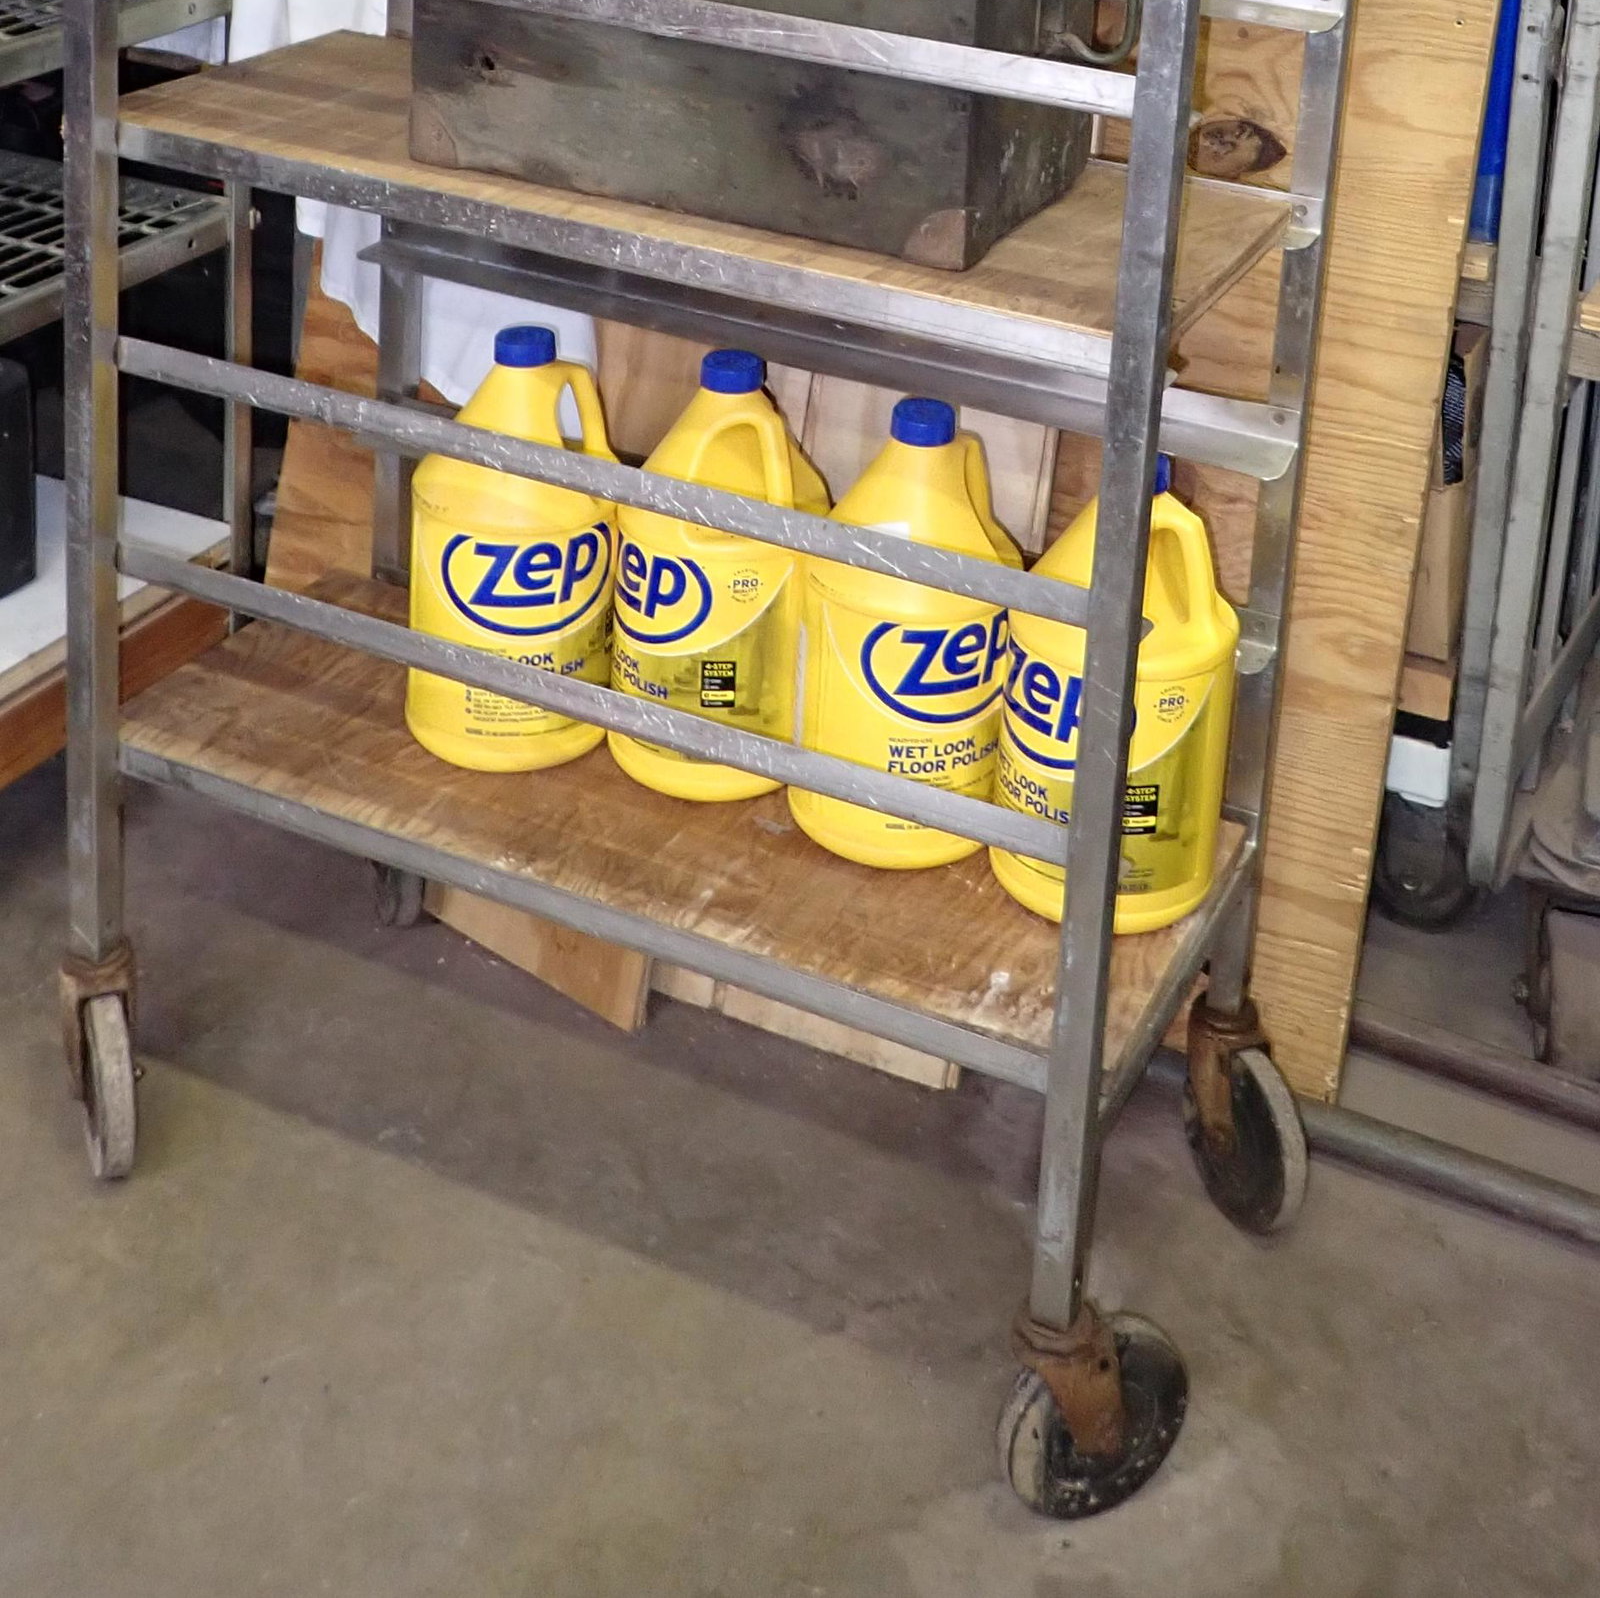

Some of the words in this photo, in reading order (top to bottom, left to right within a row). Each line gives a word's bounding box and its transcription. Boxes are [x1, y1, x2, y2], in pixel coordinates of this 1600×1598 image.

[733, 578, 759, 589] PRO
[624, 667, 668, 700] POLISH
[704, 669, 734, 677] SYSTEM
[1159, 695, 1185, 708] PRO
[887, 759, 946, 774] FLOOR
[952, 737, 999, 769] POLISH
[889, 744, 928, 759] WET
[934, 736, 976, 757] LOOK
[1014, 767, 1048, 802] LOOK
[1025, 793, 1070, 824] POLIS
